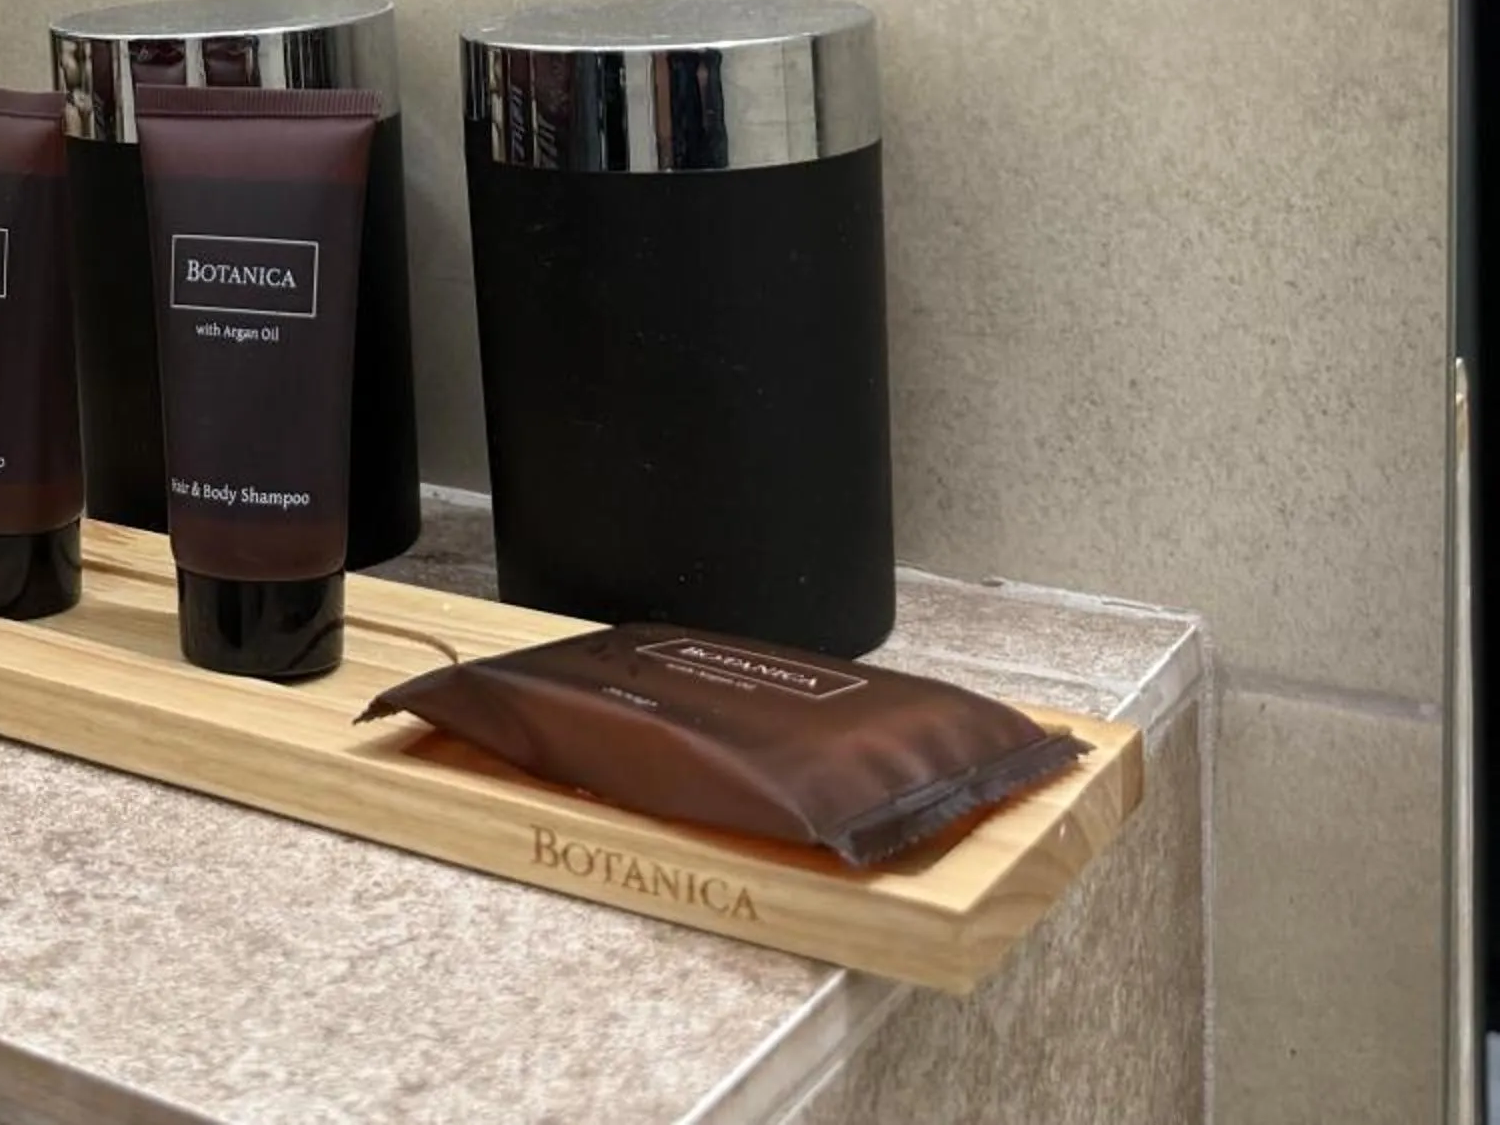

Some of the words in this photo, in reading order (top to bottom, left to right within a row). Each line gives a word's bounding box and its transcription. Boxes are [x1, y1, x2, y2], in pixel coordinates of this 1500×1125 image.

[186, 259, 296, 288] BOTANICA
[196, 323, 220, 336] with
[224, 325, 258, 342] Argan
[261, 326, 279, 341] Oil
[191, 481, 200, 497] &
[203, 483, 237, 505] Body
[241, 486, 310, 510] Shampoo
[530, 825, 759, 921] BOTANICA
